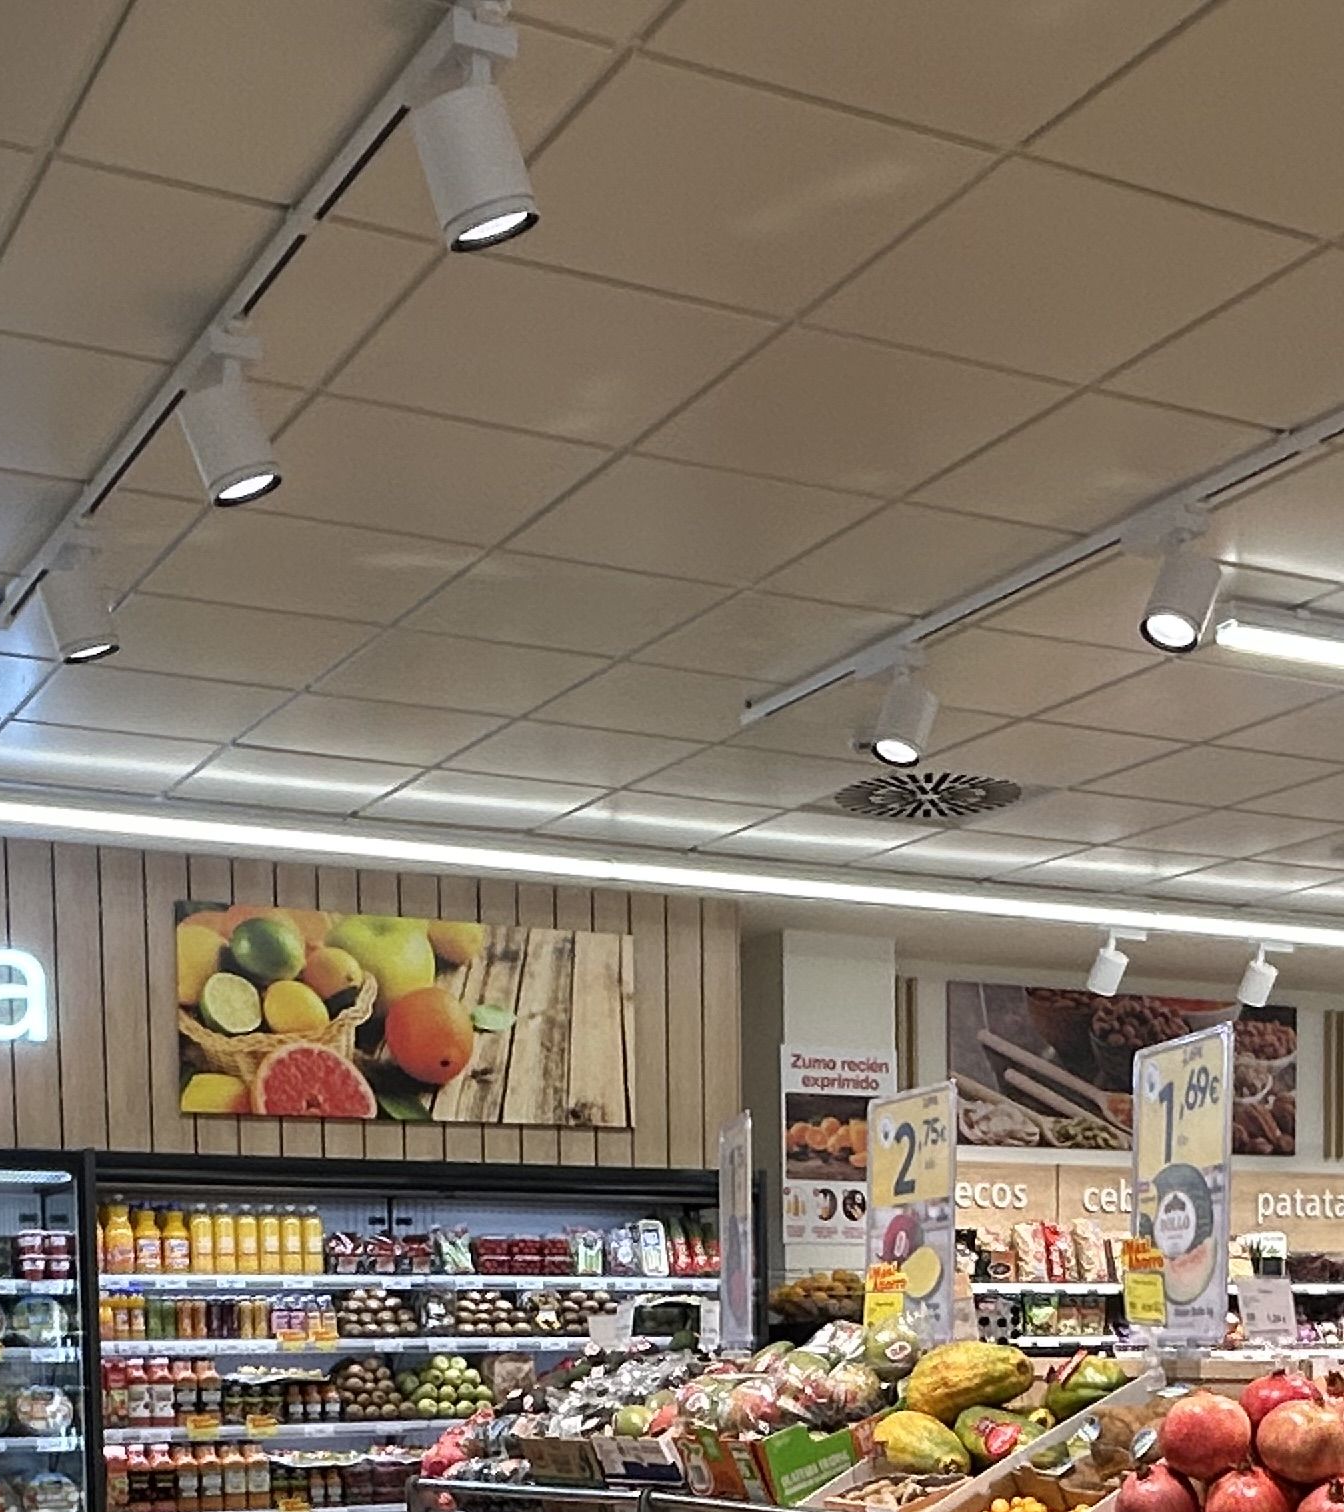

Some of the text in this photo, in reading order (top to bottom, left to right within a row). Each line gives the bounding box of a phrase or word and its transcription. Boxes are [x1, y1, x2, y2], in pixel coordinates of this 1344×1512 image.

[790, 1053, 890, 1074] Zumo recién
[801, 1073, 880, 1092] exprimido
[955, 1181, 1029, 1209] ecos
[1083, 1178, 1134, 1213] ceb
